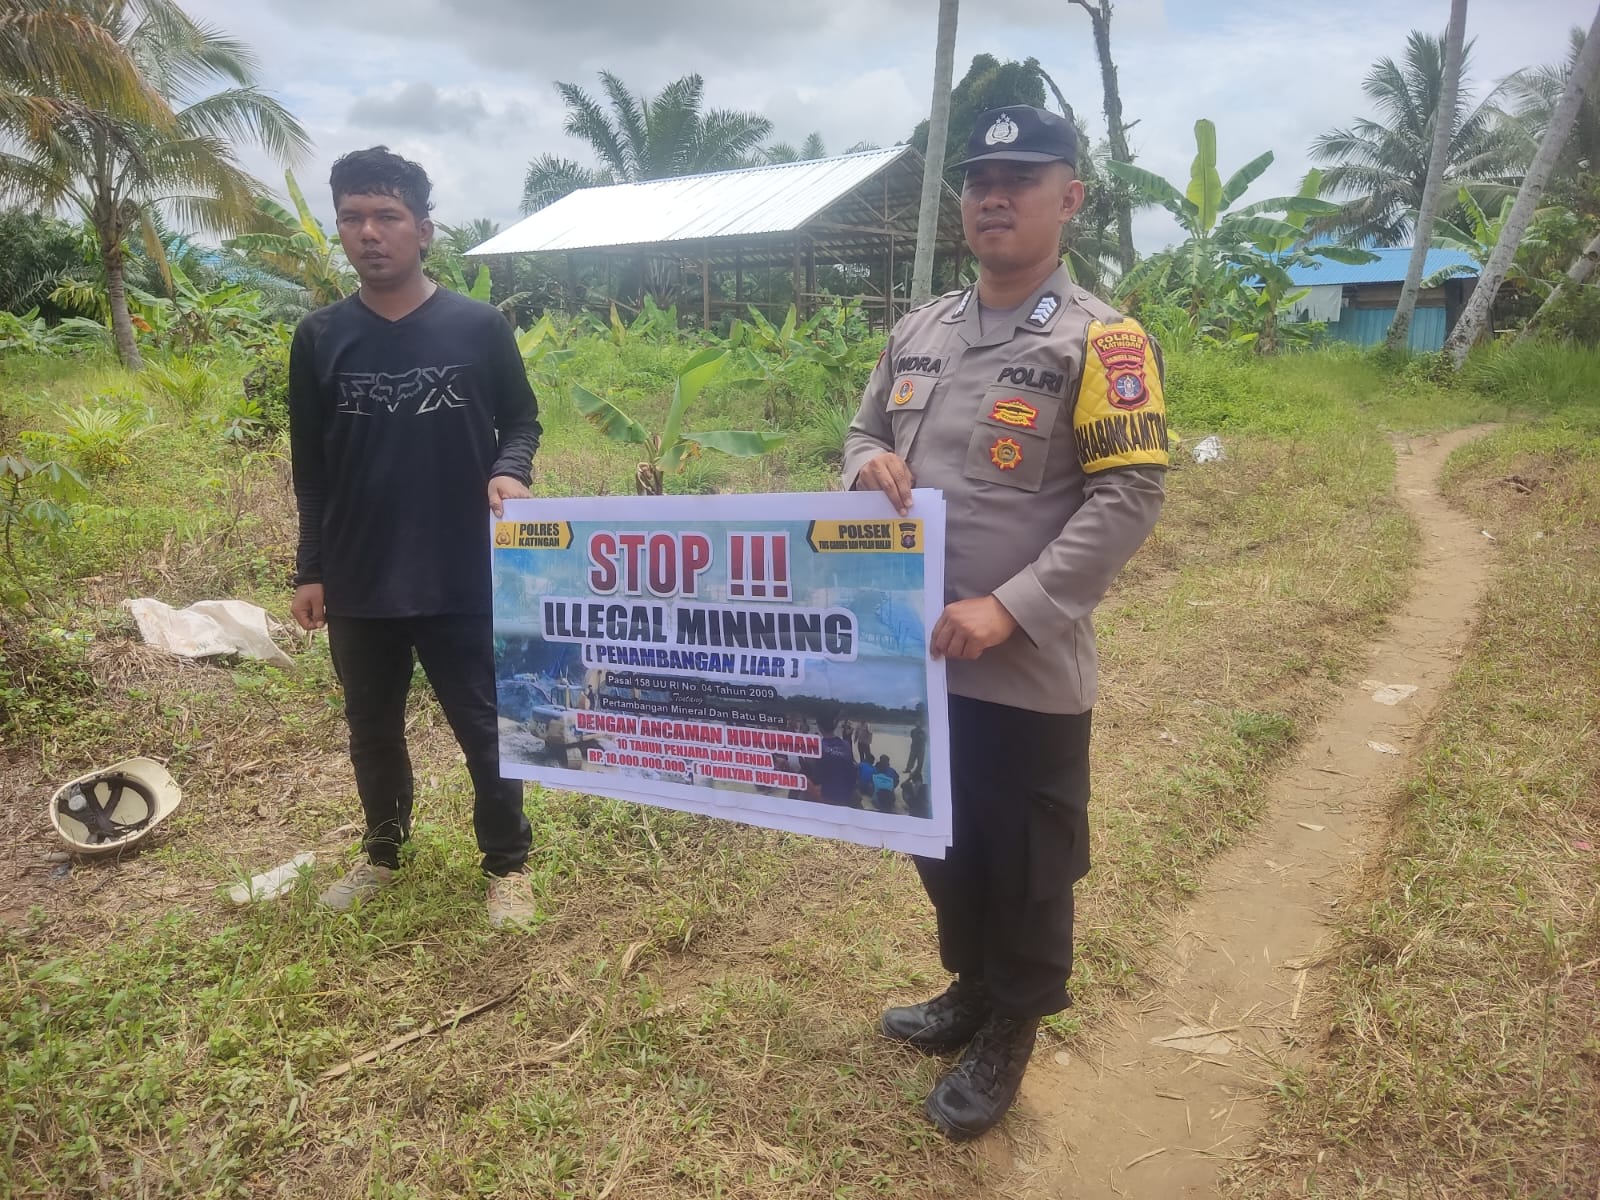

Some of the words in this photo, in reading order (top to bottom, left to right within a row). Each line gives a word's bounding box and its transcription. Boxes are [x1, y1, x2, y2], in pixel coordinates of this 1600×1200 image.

[897, 355, 941, 373] INDRA
[997, 366, 1064, 394] POLRI
[518, 536, 560, 548] KATINGAN
[519, 523, 560, 537] POLRES
[838, 524, 891, 539] POLSEK
[590, 533, 710, 594] STOP
[730, 535, 788, 598] !!!
[544, 602, 668, 644] ILLEGAL
[676, 608, 853, 655] MINNING
[596, 645, 736, 673] PENAMBANGAN
[740, 654, 786, 678] LIAR
[608, 675, 632, 686] Pasal
[635, 678, 650, 688] 158
[653, 680, 667, 689] UU
[669, 680, 679, 690] RI
[701, 683, 713, 693] 04
[715, 685, 746, 696] Tahun
[749, 688, 774, 699] 2009
[602, 698, 668, 713] Pertambangan
[671, 704, 707, 716] Mineral
[709, 708, 729, 719] Dan
[731, 711, 756, 721] Batu
[759, 713, 785, 724] Bara
[576, 713, 637, 736] DENGAN
[640, 720, 723, 745] ANCAMAN
[727, 728, 820, 756] HUKUMAN
[616, 739, 628, 750] 10
[630, 740, 662, 755] TAHUN
[664, 744, 710, 760] PENJARA
[711, 749, 733, 763] DAN
[735, 751, 773, 768] DENDA
[699, 763, 712, 777] 10
[713, 765, 753, 781] MILYAR
